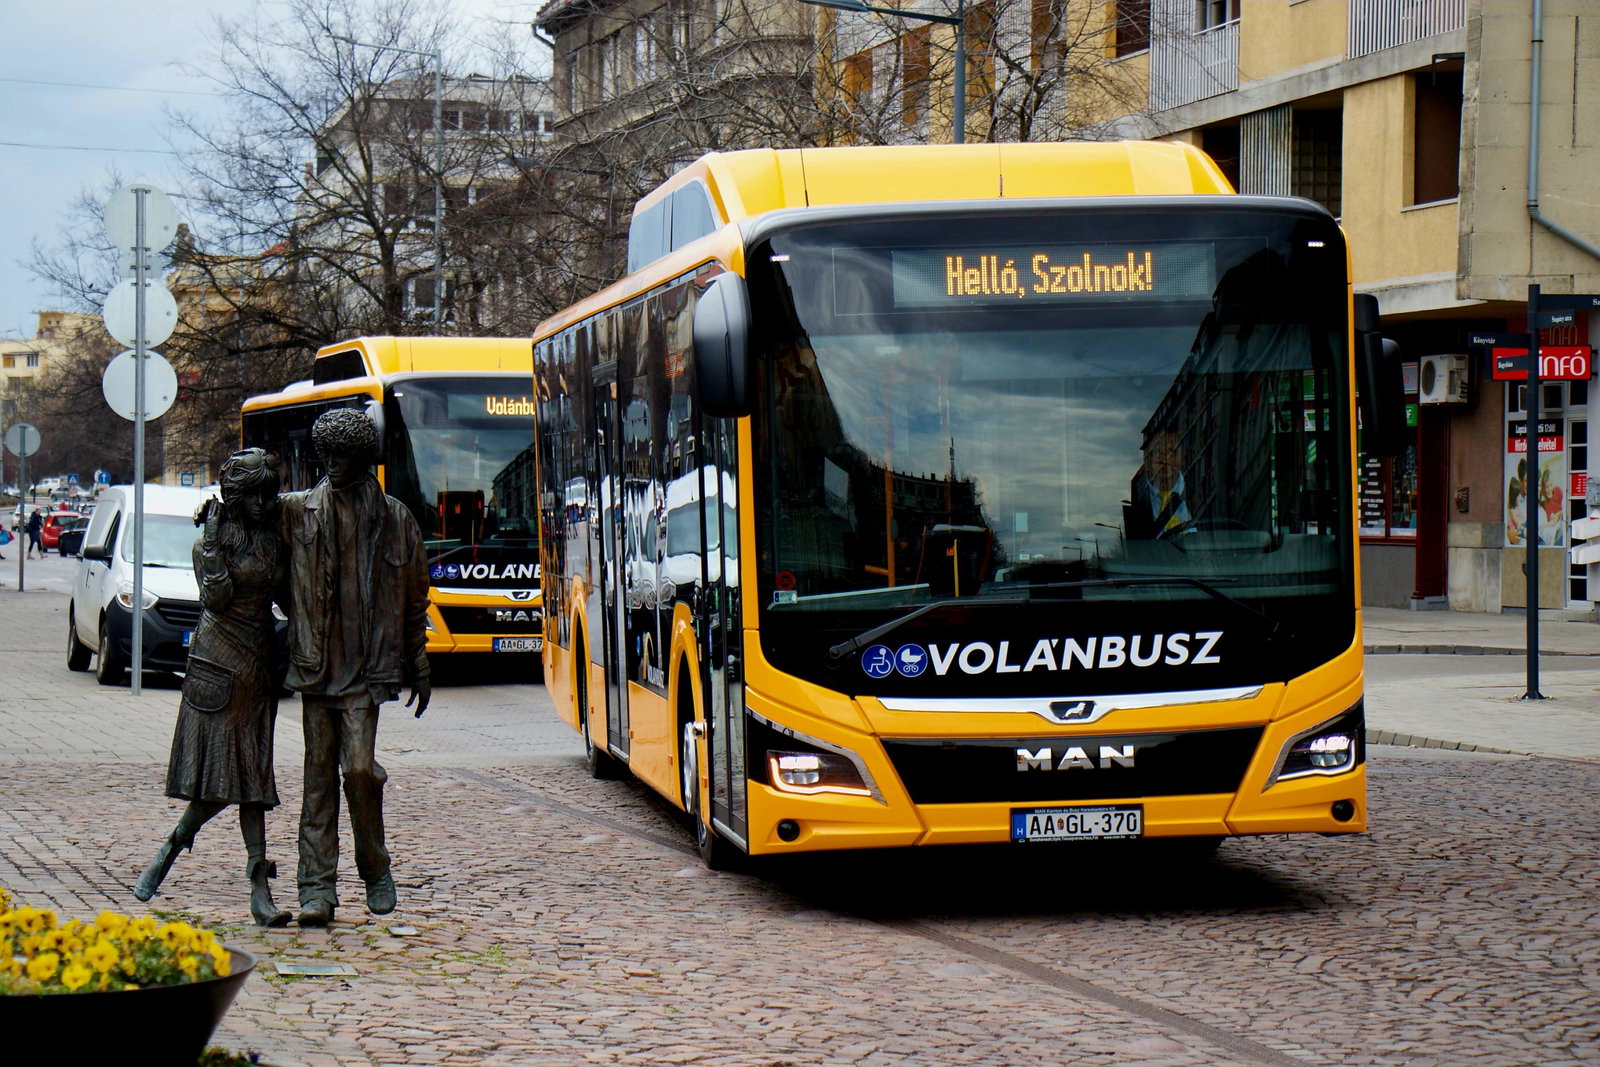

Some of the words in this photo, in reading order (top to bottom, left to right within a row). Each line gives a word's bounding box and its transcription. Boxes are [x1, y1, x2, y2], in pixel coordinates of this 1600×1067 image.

[946, 255, 1025, 299] Helló,
[1032, 251, 1152, 294] Szolnok!
[496, 610, 543, 622] MAN
[928, 631, 1224, 676] VOLÁNBUSZ
[1016, 744, 1135, 772] MAN
